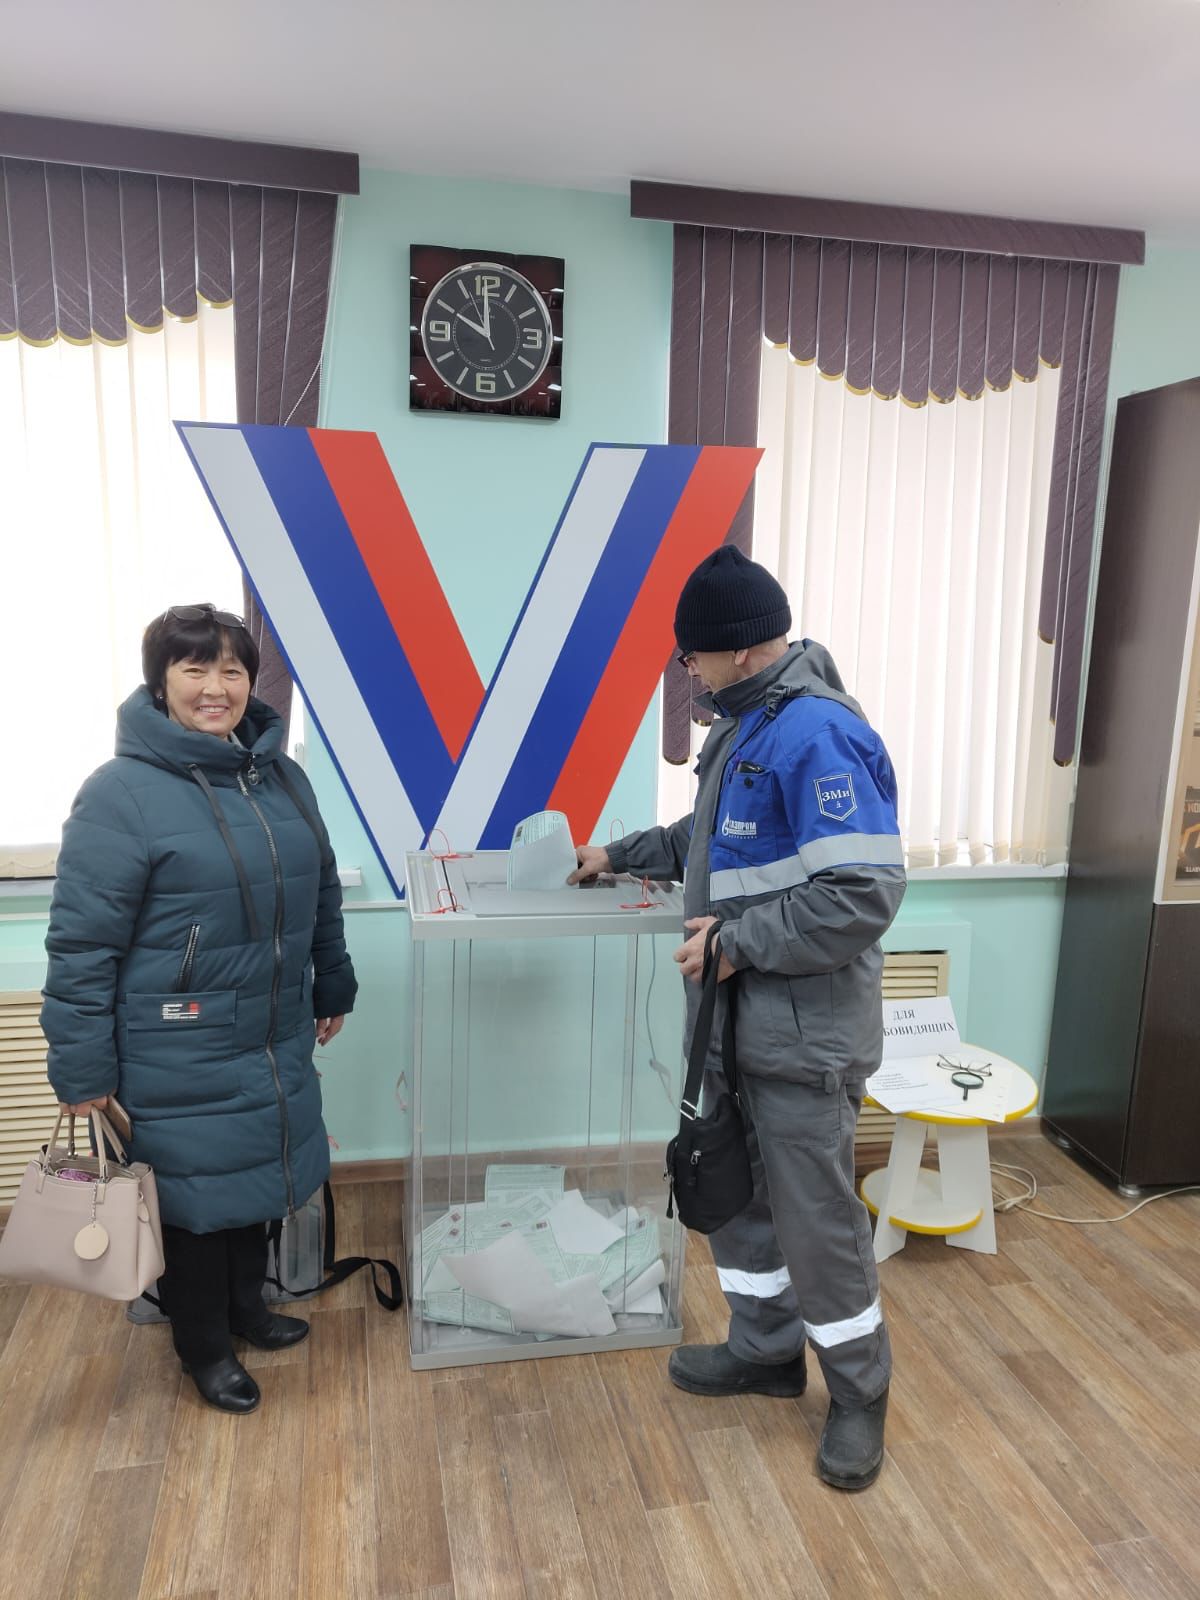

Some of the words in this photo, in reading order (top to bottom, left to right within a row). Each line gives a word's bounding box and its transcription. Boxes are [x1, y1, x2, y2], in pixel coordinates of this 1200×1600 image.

[474, 274, 500, 298] 12
[429, 320, 451, 342] 9
[522, 327, 543, 350] 3
[475, 372, 496, 393] 6
[893, 1009, 915, 1021] ДЛЯ
[883, 1022, 955, 1036] БОВИДЯЩИХ
